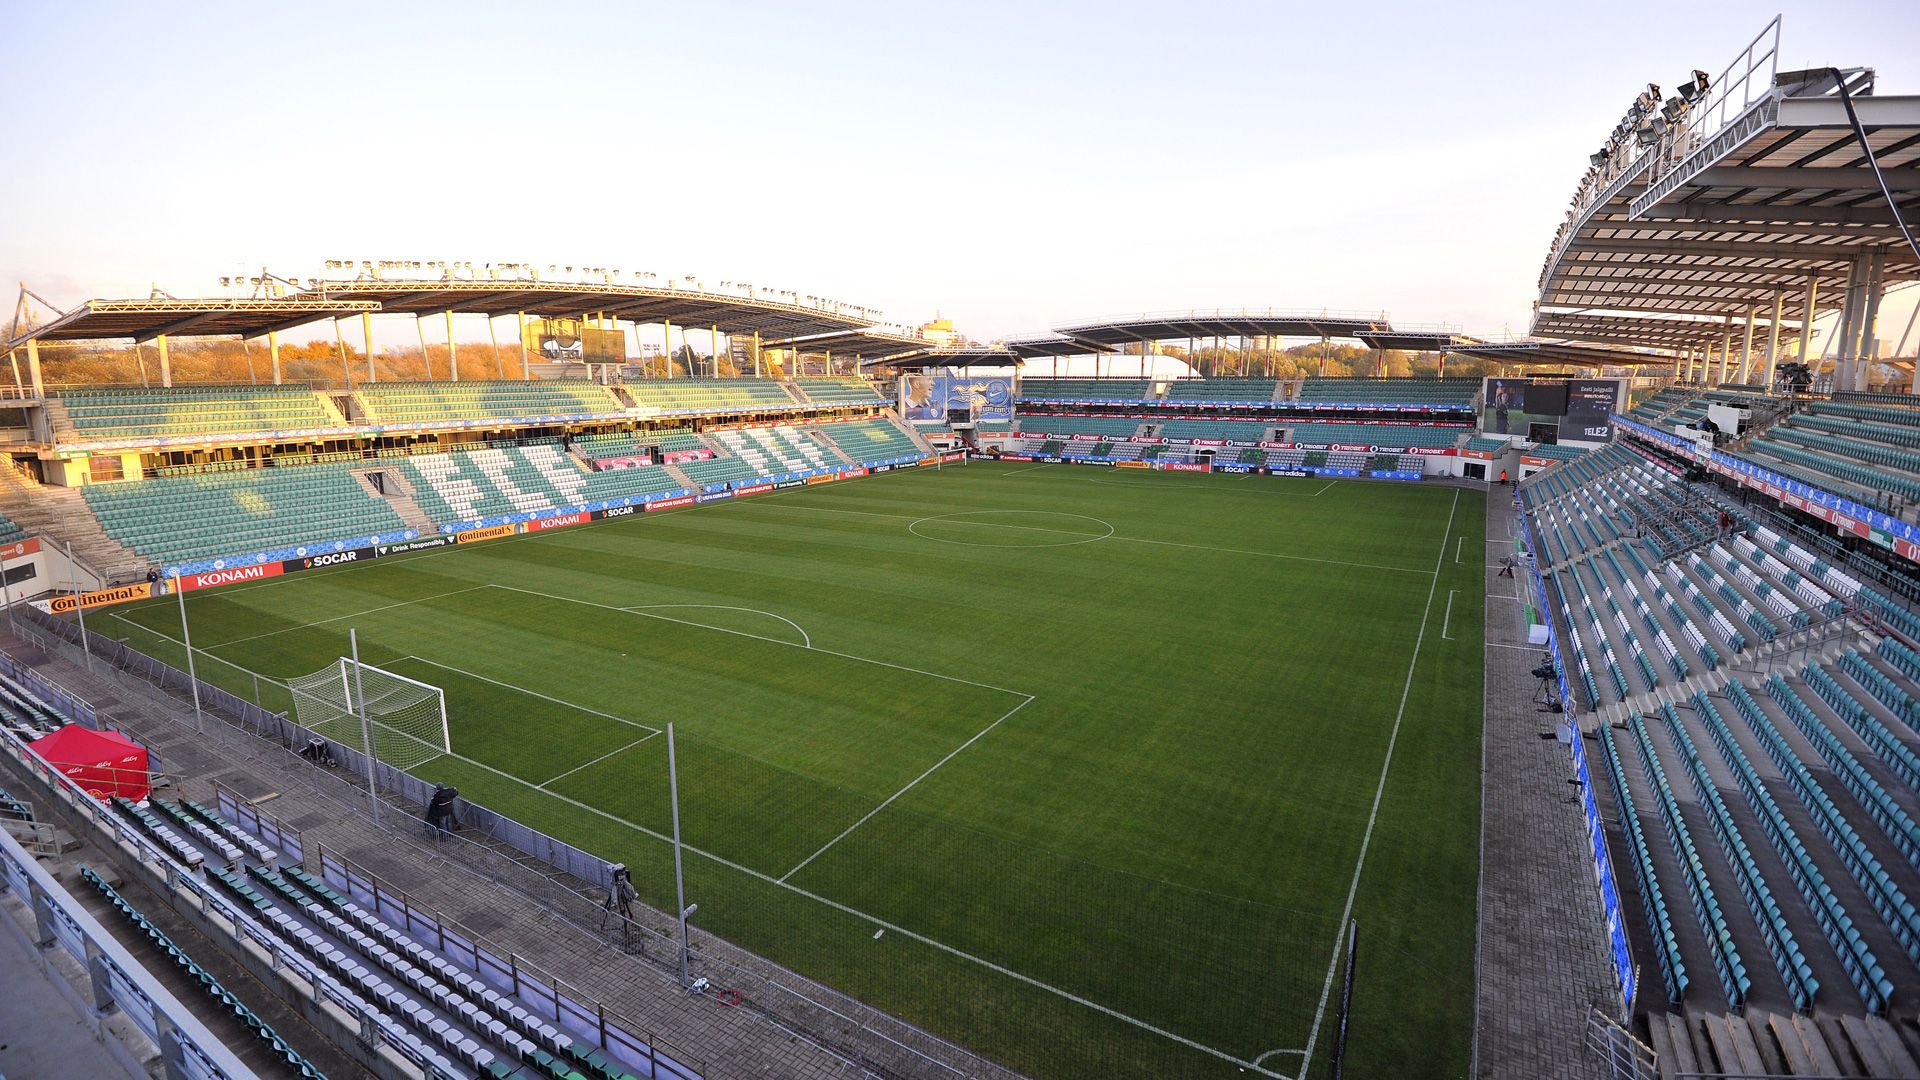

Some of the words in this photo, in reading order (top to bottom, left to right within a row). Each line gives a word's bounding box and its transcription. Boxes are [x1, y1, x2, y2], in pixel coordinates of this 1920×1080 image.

[1584, 426, 1608, 437] TELE2
[1173, 463, 1201, 471] KONAMI
[845, 469, 864, 478] KONAMI
[652, 501, 673, 509] EUROPEAN
[673, 498, 693, 506] QUALIFIERS
[607, 507, 634, 518] SOCAR
[540, 515, 580, 529] KONAMI
[458, 526, 505, 542] Continental
[392, 544, 409, 553] Drink
[410, 538, 445, 550] Responsibly
[313, 551, 357, 567] SOCAR
[197, 566, 264, 587] KONAMI
